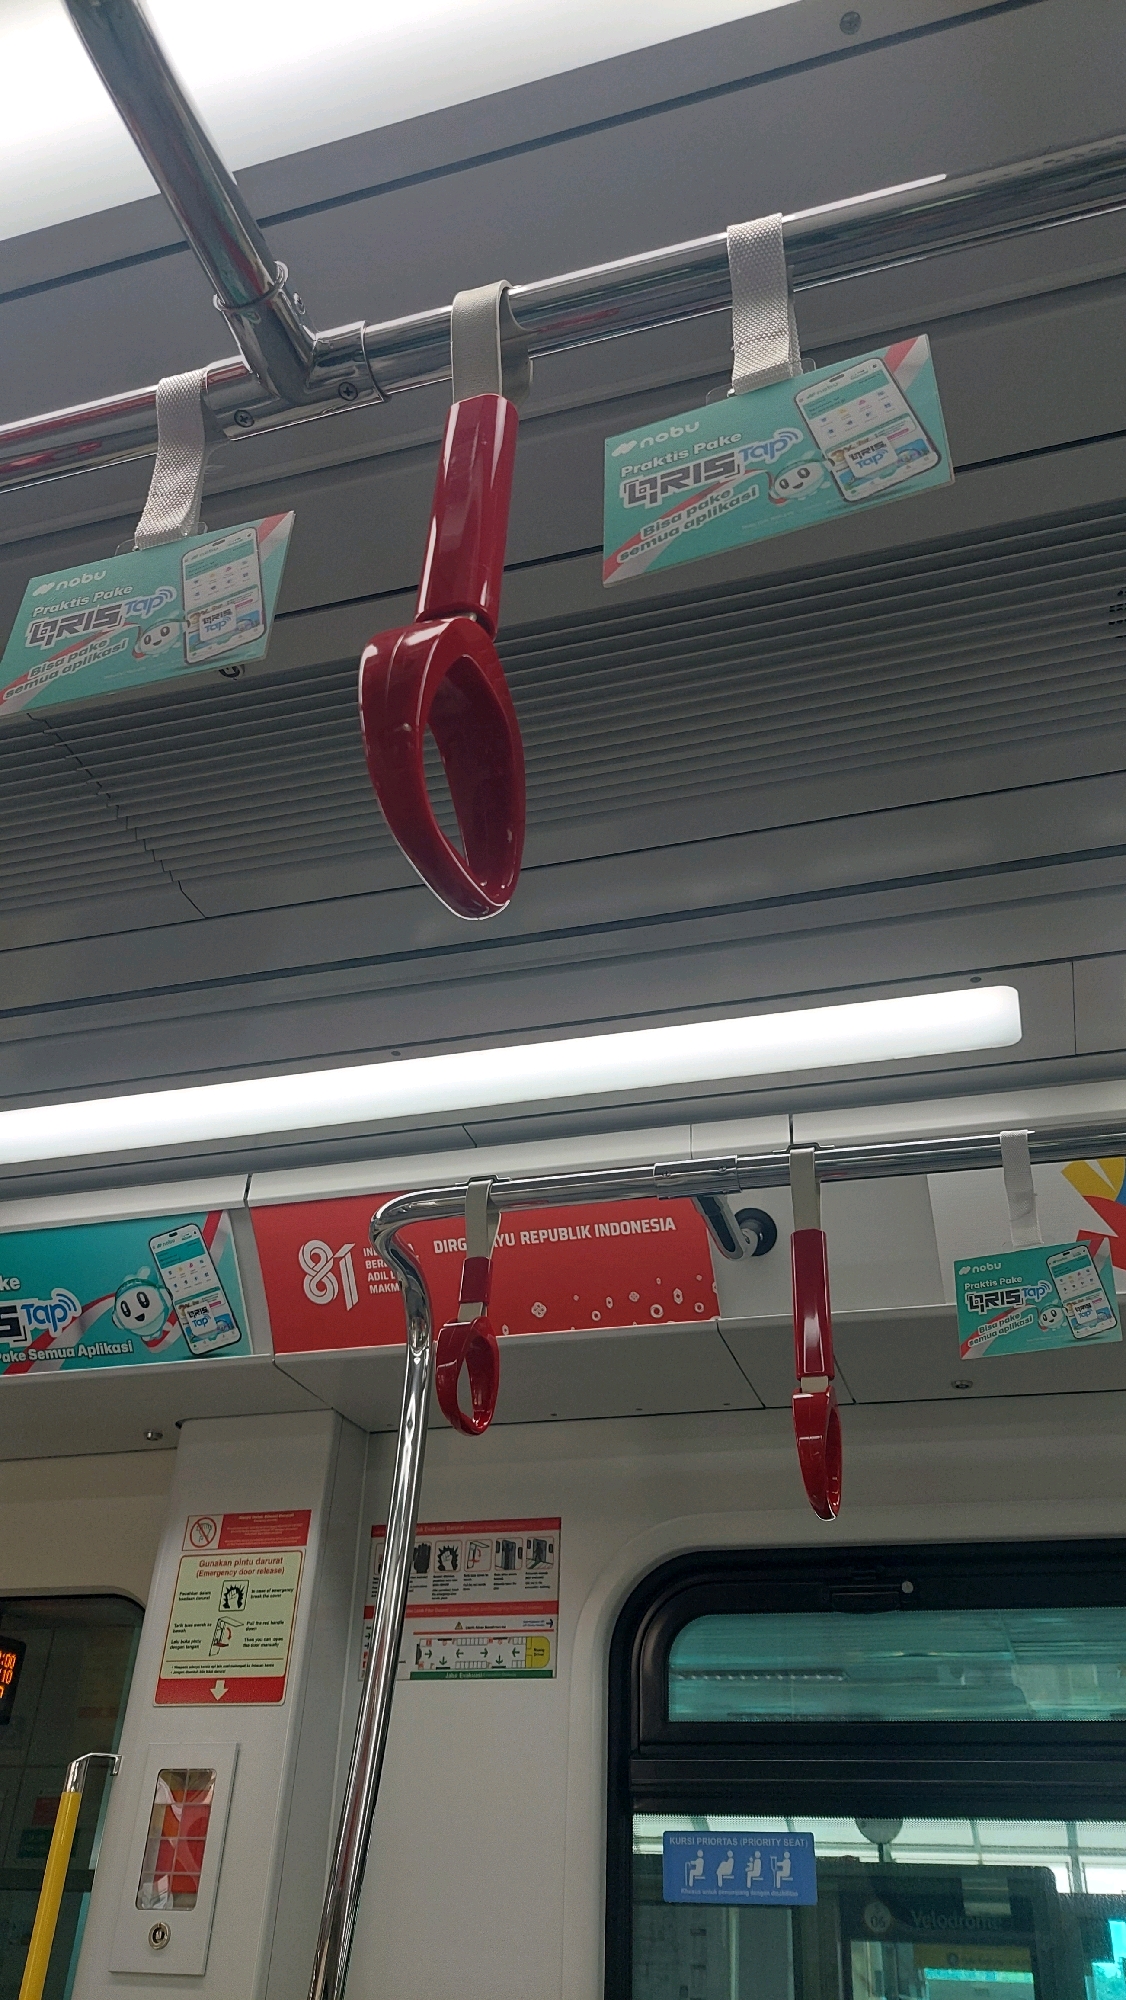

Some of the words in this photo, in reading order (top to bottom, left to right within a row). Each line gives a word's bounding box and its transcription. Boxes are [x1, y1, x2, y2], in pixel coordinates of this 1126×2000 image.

[640, 421, 699, 448] nobu
[621, 449, 690, 477] Praktis
[693, 432, 742, 454] Pake
[623, 452, 742, 504] QRIS
[739, 440, 789, 461] Tap
[620, 526, 680, 561] semua
[684, 489, 758, 530] aplikasi
[643, 514, 682, 538] Bisa
[686, 488, 733, 519] pake
[56, 570, 107, 591] nobu
[32, 596, 90, 618] Praktis
[93, 586, 133, 603] Pake
[29, 603, 123, 646] QRIS
[124, 595, 163, 615] Tap
[5, 669, 59, 698] semua
[62, 640, 127, 672] aplikasi
[30, 656, 65, 678] Bisa
[67, 639, 108, 663] pake
[433, 1232, 516, 1254] DIRGYU
[520, 1224, 592, 1245] REPUBLIK
[594, 1217, 676, 1238] INDONESIA
[298, 1239, 359, 1312] 81
[367, 1271, 390, 1282] ADIL
[972, 1262, 1001, 1274] nobu
[0, 1275, 20, 1291] ke
[369, 1282, 401, 1294] MAKM
[964, 1279, 998, 1290] Praktis
[1000, 1276, 1023, 1286] Pake
[967, 1288, 1024, 1313] QRIS
[1022, 1287, 1046, 1300] Tap
[20, 1303, 68, 1333] Tap
[968, 1331, 997, 1347] semua
[998, 1315, 1033, 1335] aplikasi
[978, 1321, 998, 1334] Bisa
[999, 1312, 1021, 1327] pake
[0, 1350, 26, 1363] ake
[28, 1347, 76, 1360] Semua
[78, 1340, 134, 1358] Aplikasi
[196, 1570, 238, 1579] (Emergency
[238, 1568, 256, 1577] door
[256, 1567, 285, 1576] release)
[198, 1558, 232, 1568] Gunakan
[234, 1557, 254, 1567] pintu
[255, 1556, 284, 1566] darurat
[669, 1837, 695, 1846] KURSI
[697, 1837, 738, 1846] PRIORTAS
[740, 1838, 780, 1847] (PRIORITY
[783, 1839, 809, 1848] SEAT)
